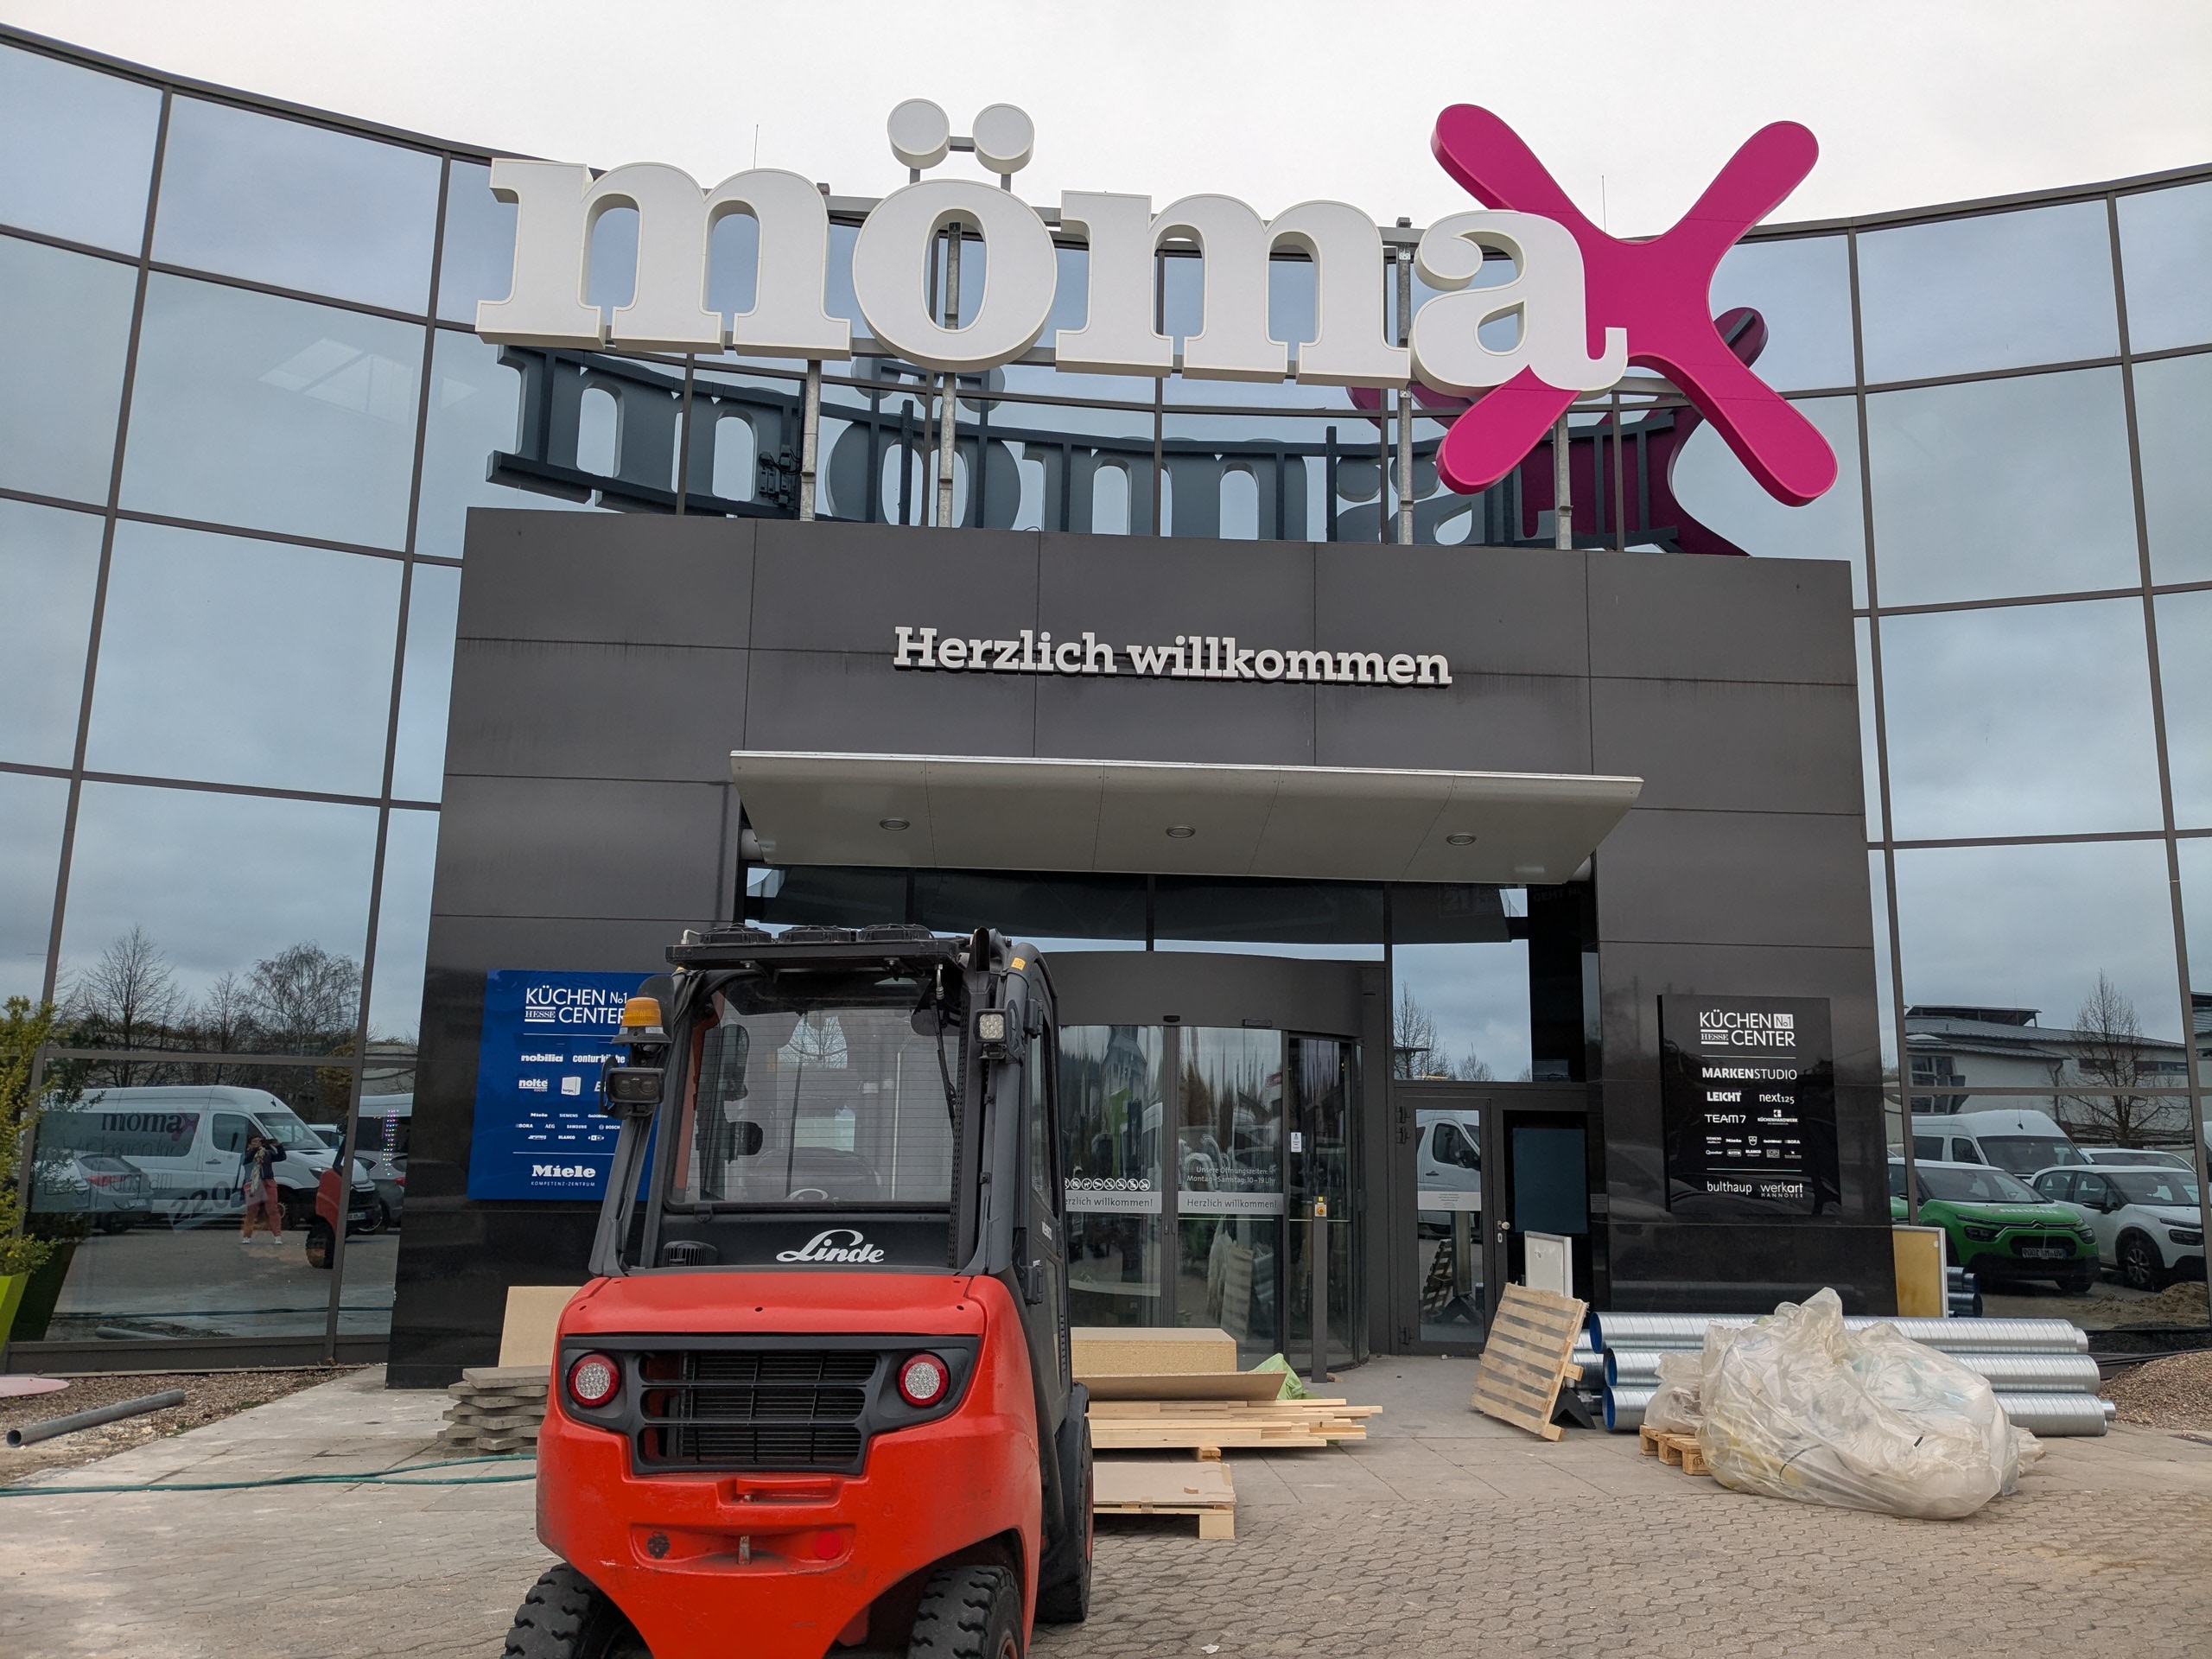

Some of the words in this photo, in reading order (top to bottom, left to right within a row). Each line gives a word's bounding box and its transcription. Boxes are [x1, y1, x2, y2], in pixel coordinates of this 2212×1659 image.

[475, 99, 1838, 507] mömax
[893, 626, 1118, 676] Herzlich
[1127, 634, 1453, 686] willkommen
[525, 985, 606, 1006] KÜCHEN
[524, 1010, 556, 1019] HESSE
[1700, 1009, 1772, 1028] KÜCHEN
[1731, 1031, 1796, 1047] CENTER
[521, 1054, 563, 1063] nobilia
[1702, 1067, 1797, 1080] MARKENSTUDIO
[518, 1078, 548, 1088] nolte
[1707, 1091, 1741, 1103] LEICHT
[1759, 1093, 1795, 1104] next125
[531, 1165, 596, 1178] Miele
[1707, 1181, 1752, 1195] bulthaup
[1760, 1183, 1803, 1193] werkart
[1065, 1197, 1091, 1205] erzlich
[1093, 1198, 1153, 1206] willkommen!
[1187, 1198, 1223, 1207] Herzlich
[1224, 1199, 1277, 1208] willkommen!
[776, 1229, 885, 1263] Linde
